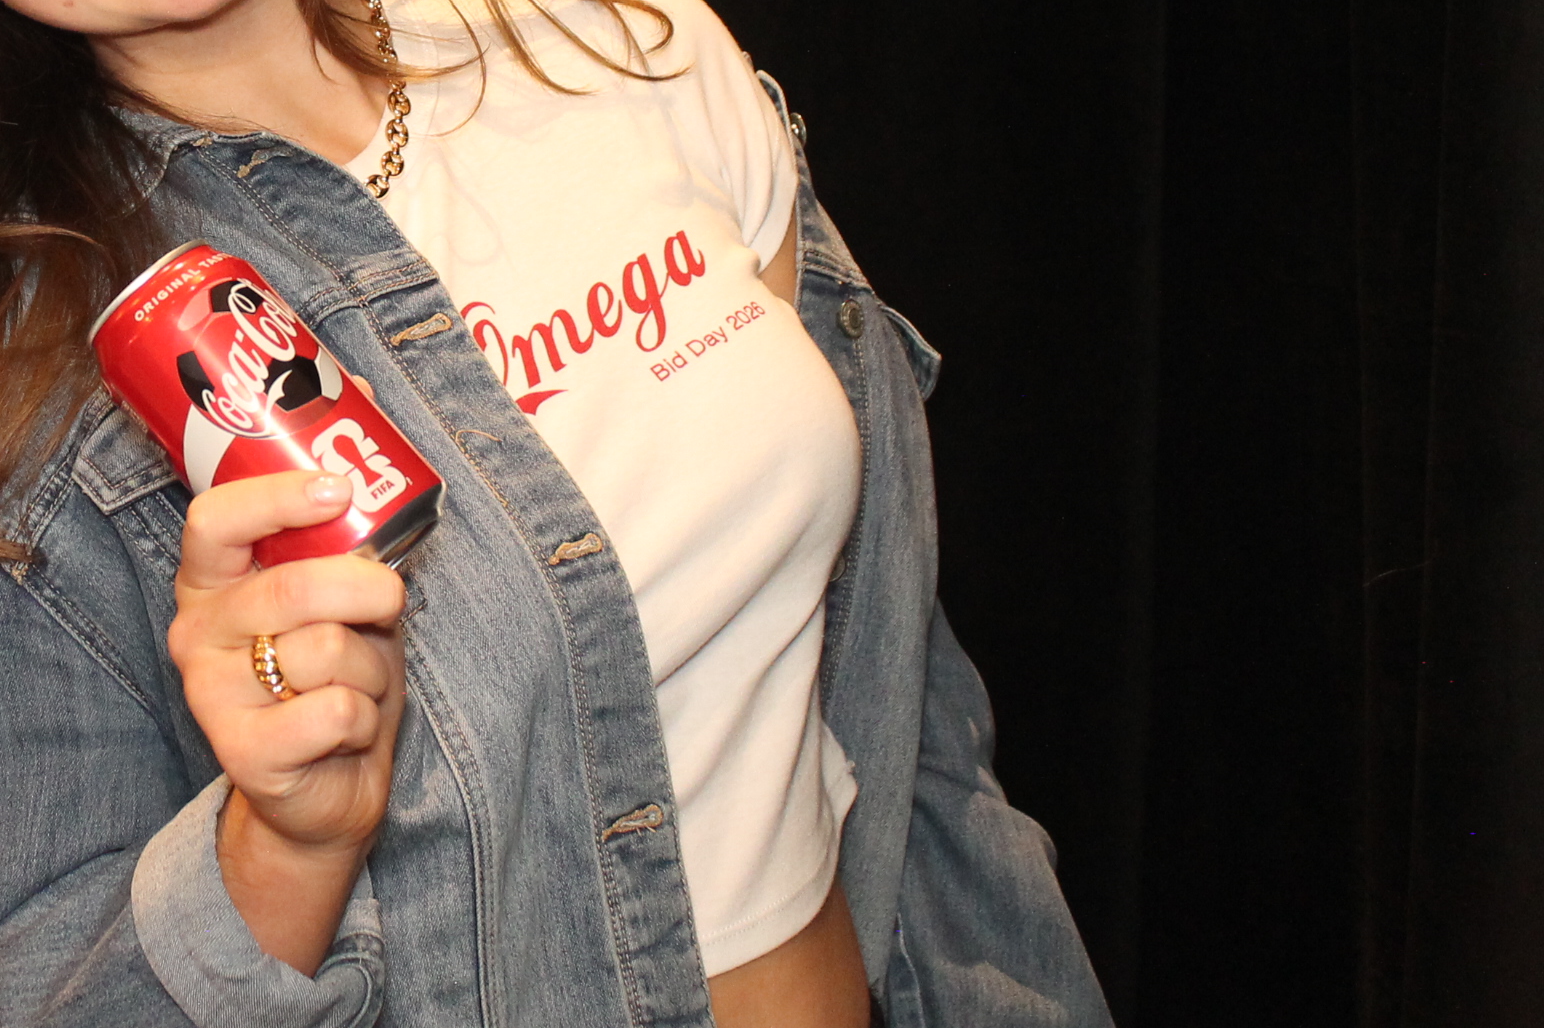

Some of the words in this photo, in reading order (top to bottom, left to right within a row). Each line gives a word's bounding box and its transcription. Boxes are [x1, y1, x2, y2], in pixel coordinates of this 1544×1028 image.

[134, 267, 201, 322] ORIGINAL
[650, 351, 688, 382] Bid
[685, 326, 728, 357] Day
[726, 301, 766, 331] 2026
[370, 479, 396, 500] FIFA
